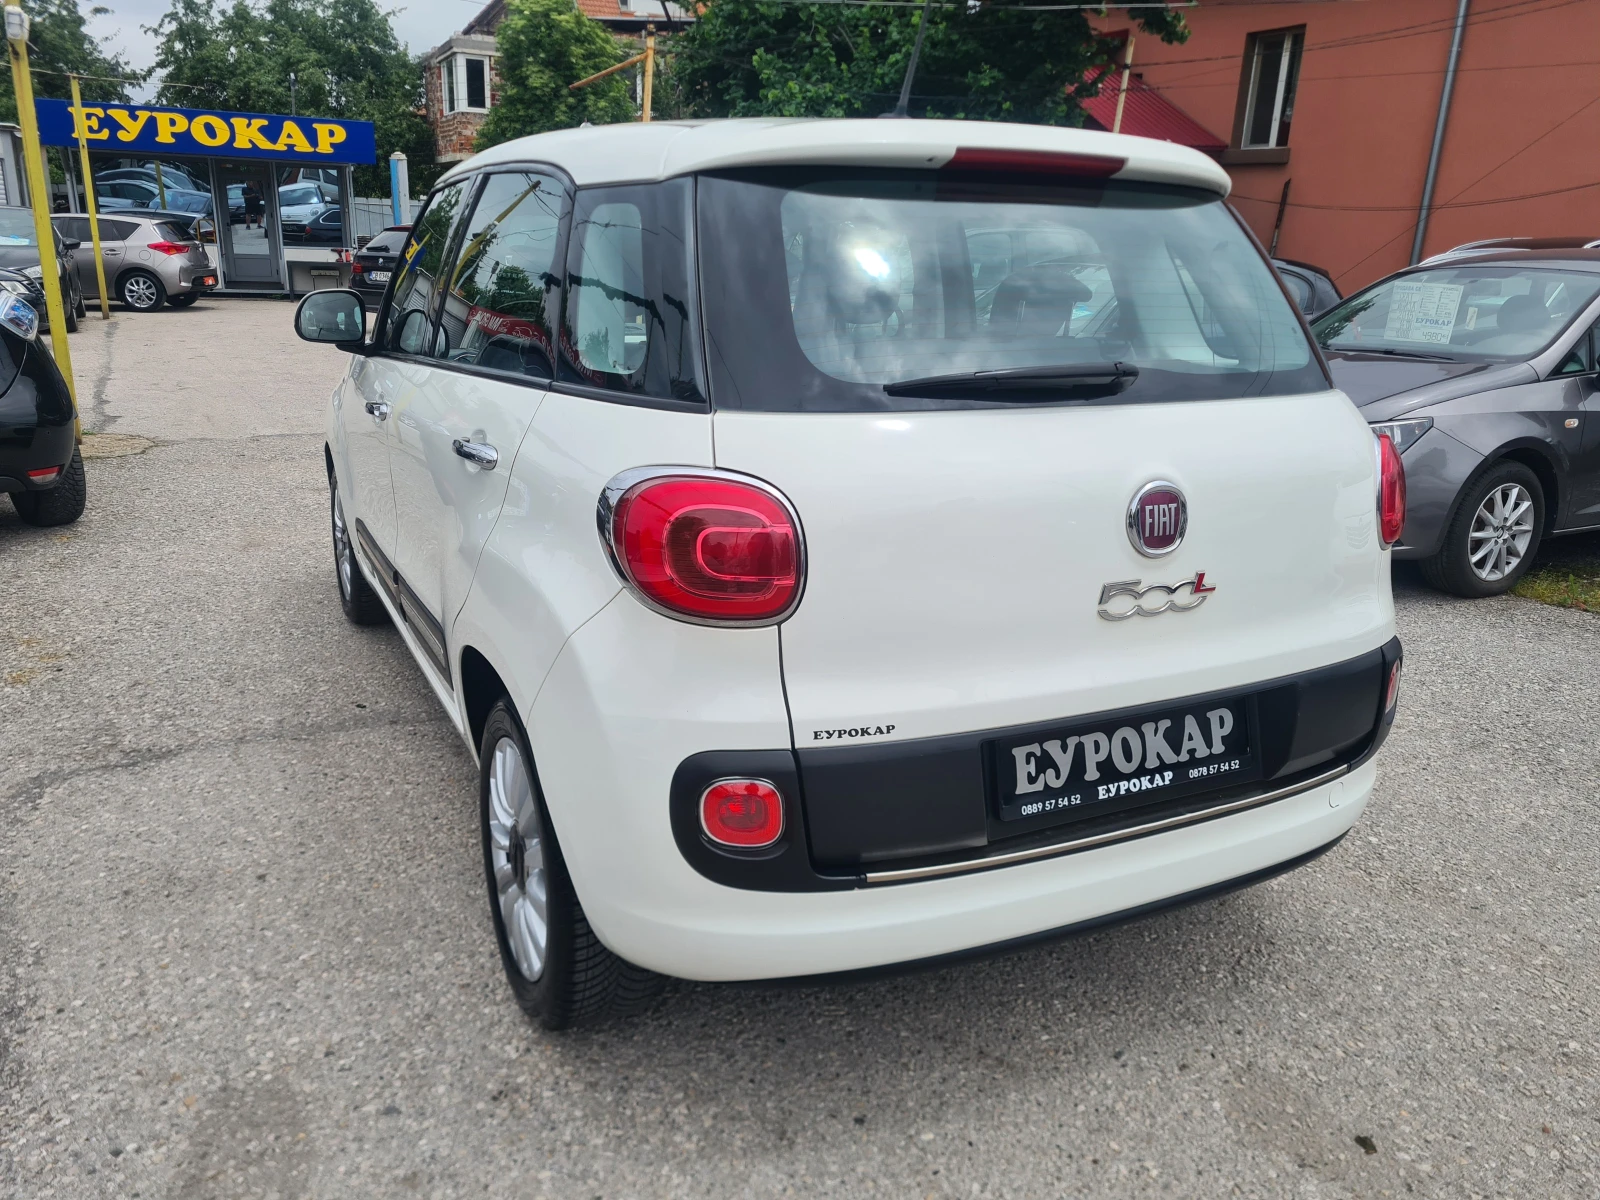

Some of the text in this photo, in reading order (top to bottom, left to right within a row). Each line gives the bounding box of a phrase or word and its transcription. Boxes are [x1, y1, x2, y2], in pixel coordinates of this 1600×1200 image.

[67, 106, 347, 154] ЕУРОКАР
[1415, 317, 1452, 327] ЕУРОКАР
[1145, 503, 1177, 537] FIAT
[813, 725, 895, 740] ЕУРОКАР
[1012, 708, 1234, 795] ЕУРОКАР
[1188, 759, 1240, 779] 0878 57 54 52
[1098, 771, 1174, 800] ЕУРОКАР
[1021, 794, 1081, 816] 0889 57 54 52
